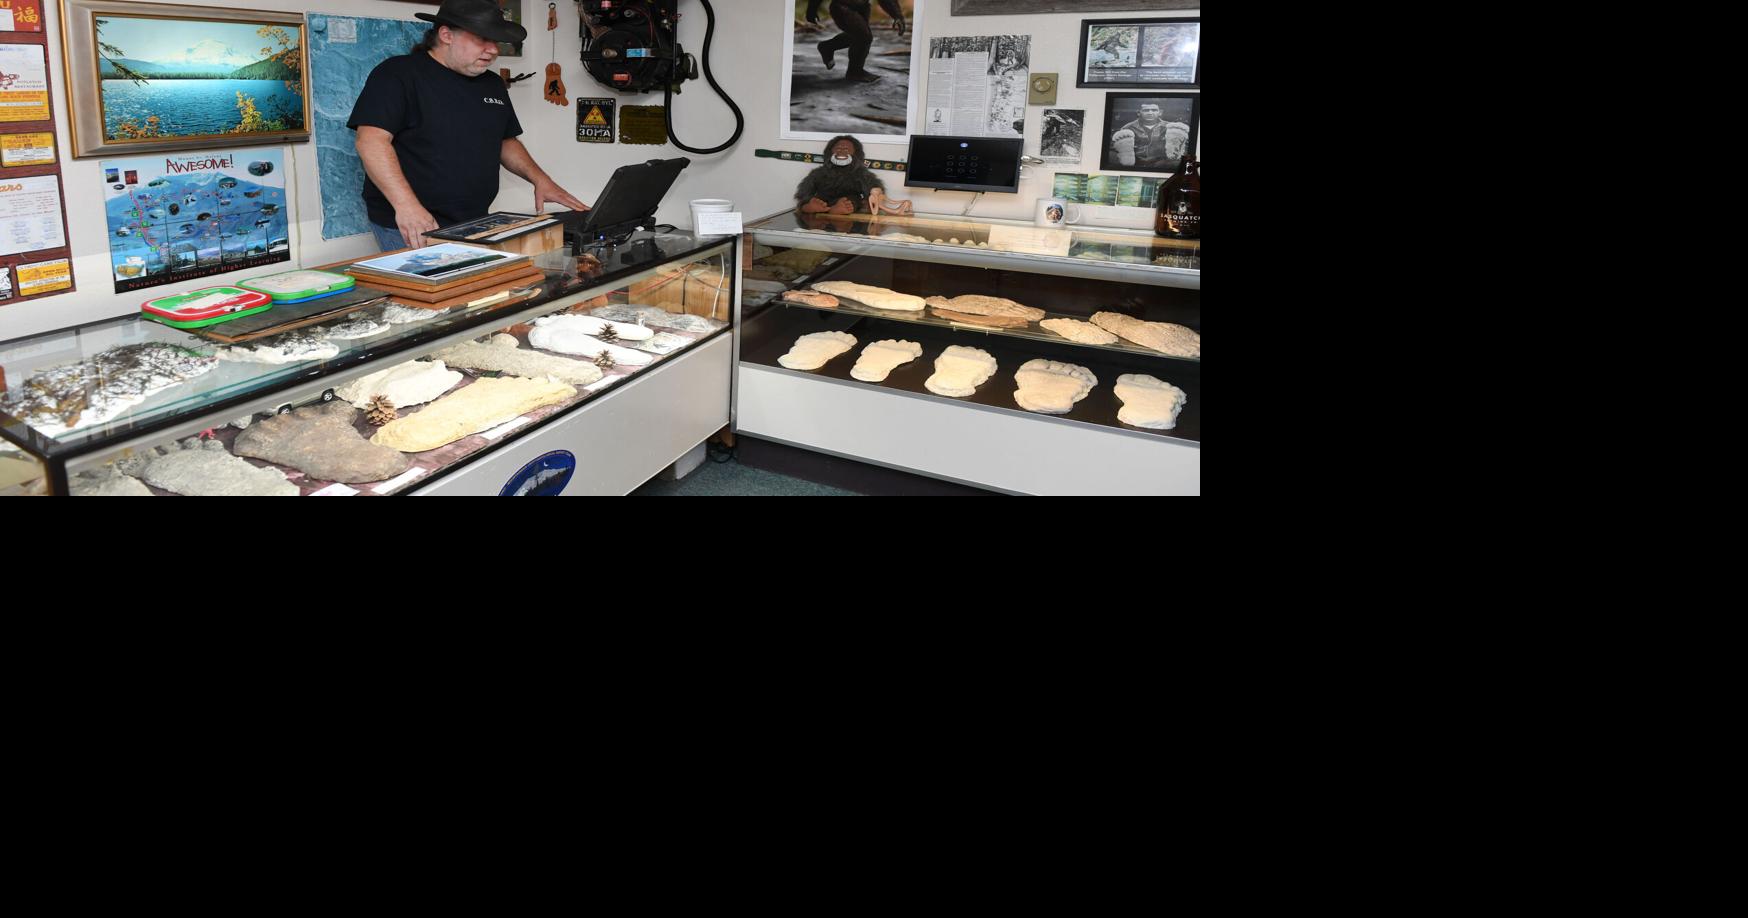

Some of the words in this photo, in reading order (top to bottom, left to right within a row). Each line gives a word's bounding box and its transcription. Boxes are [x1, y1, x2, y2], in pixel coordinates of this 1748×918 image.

[14, 6, 38, 23] 福
[166, 153, 234, 174] AWESOME!
[128, 277, 165, 289] Nature's
[170, 270, 206, 281] Institute
[210, 267, 217, 275] of
[221, 264, 246, 273] Higher
[249, 257, 281, 266] Learning
